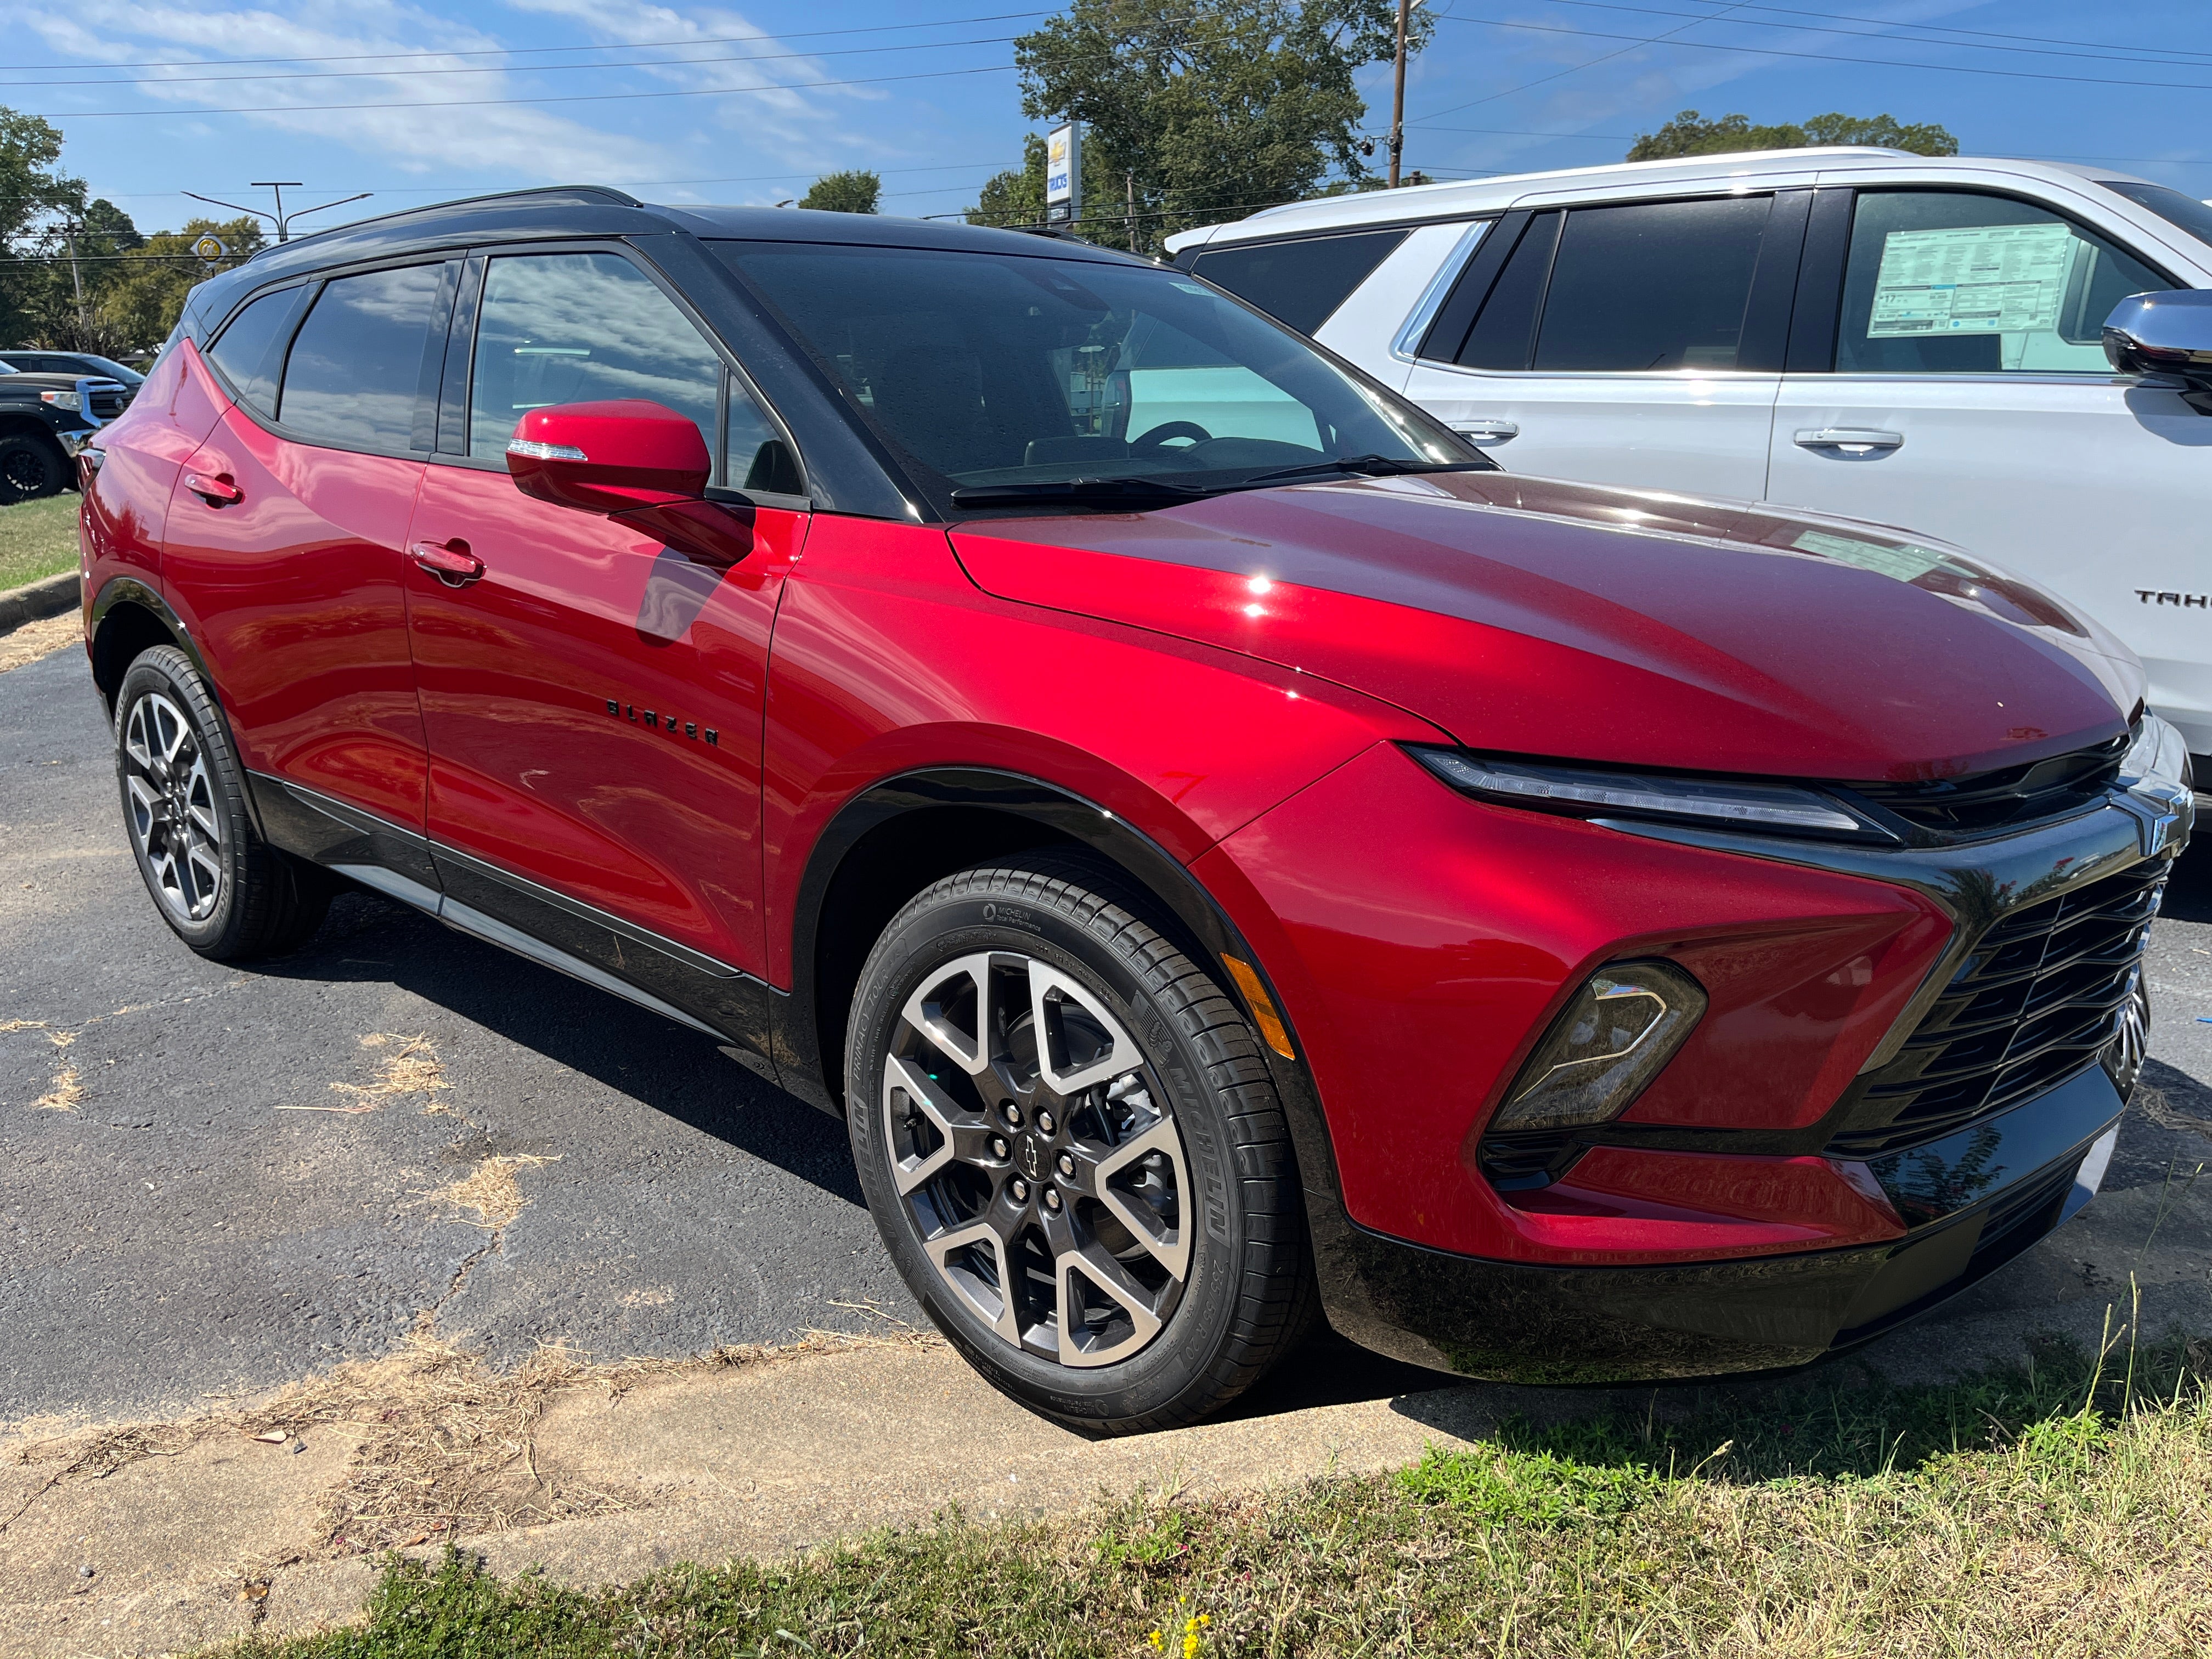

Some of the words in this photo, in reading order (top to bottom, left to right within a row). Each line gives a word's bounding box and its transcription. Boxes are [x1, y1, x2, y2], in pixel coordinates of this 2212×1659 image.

[2134, 589, 2212, 609] TAH
[607, 699, 718, 747] BLAZER
[998, 907, 1031, 921] MICHELIN
[1008, 916, 1041, 932] Performance
[853, 1008, 871, 1081] PRIMACY
[868, 968, 889, 1007] TOUR
[1169, 1067, 1226, 1236] MICHELIN
[854, 1101, 898, 1239] MICHELIN
[1202, 1259, 1224, 1325] 235/55
[1185, 1336, 1200, 1360] 20
[1195, 1323, 1208, 1339] R
